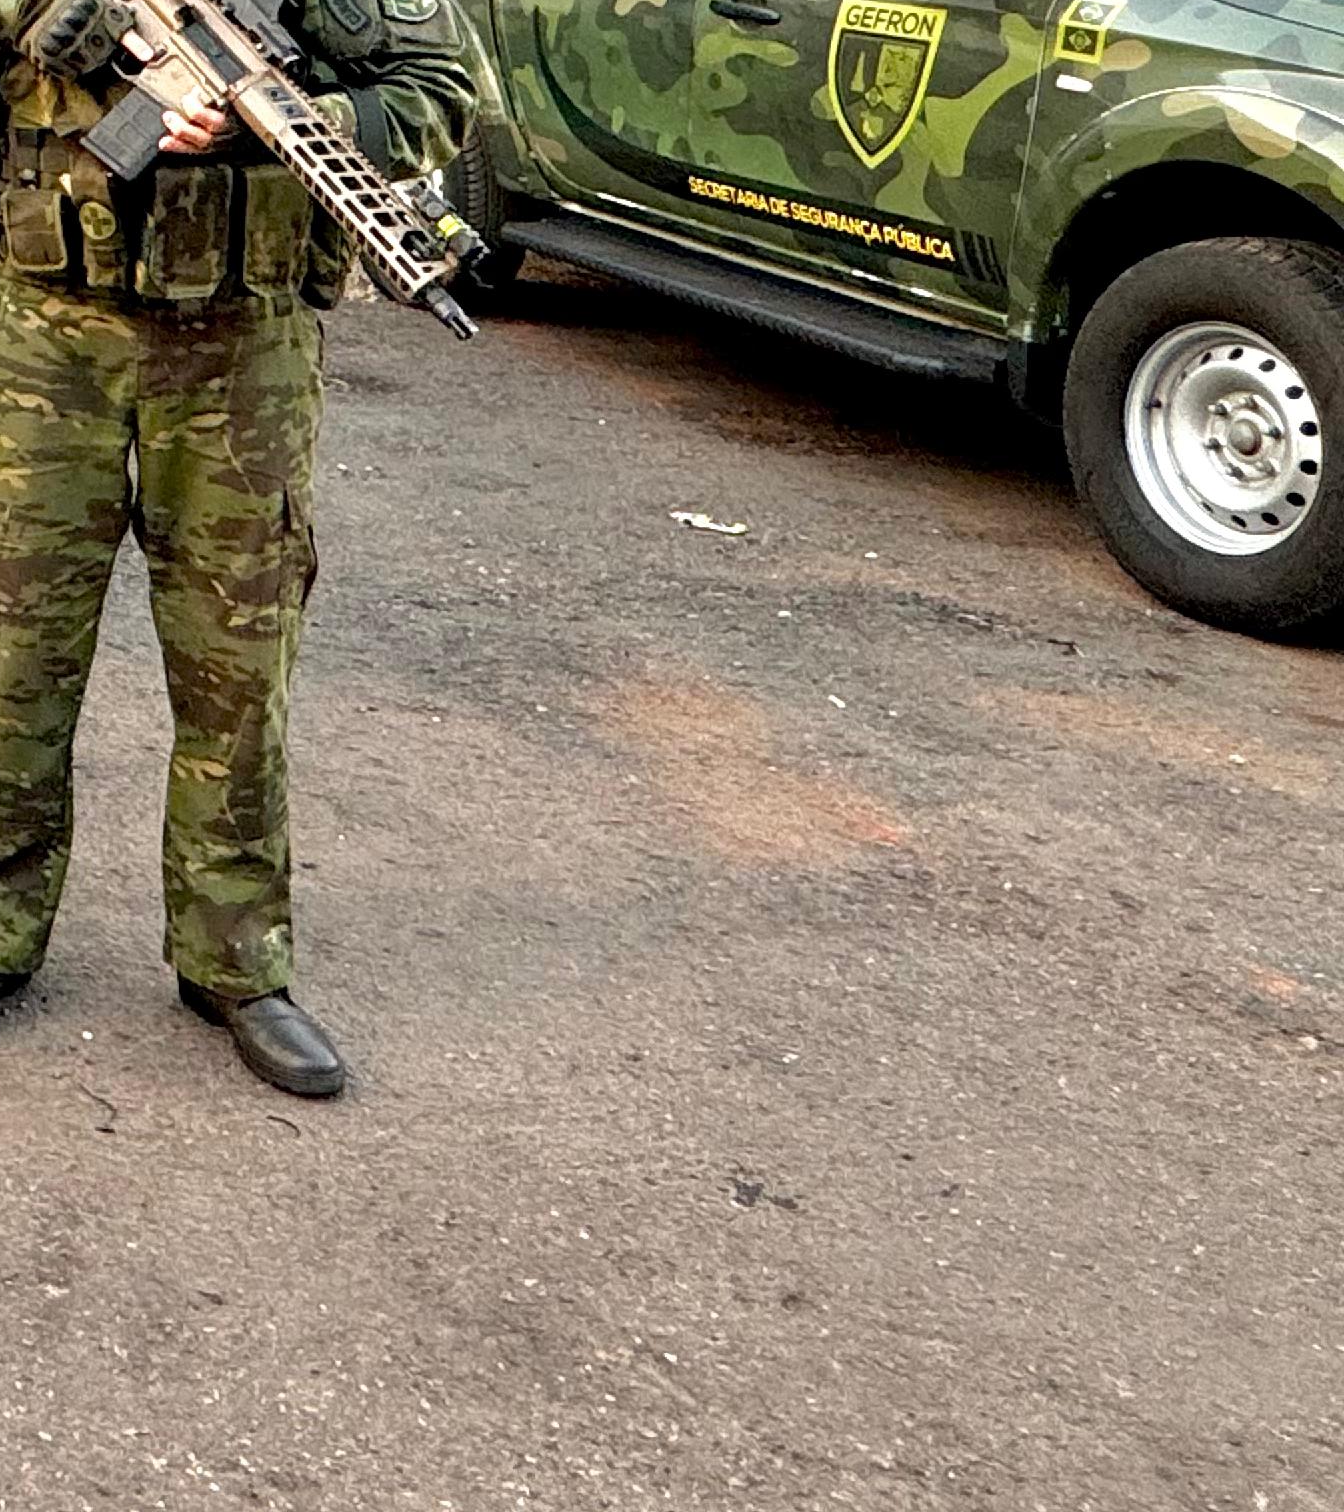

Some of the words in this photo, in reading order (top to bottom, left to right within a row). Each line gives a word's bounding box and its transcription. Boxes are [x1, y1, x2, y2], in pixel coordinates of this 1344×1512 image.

[846, 4, 938, 36] GEFRON
[688, 174, 770, 215] SECRETARIA
[770, 197, 791, 218] DE
[790, 201, 883, 246] SEGURANÇA
[884, 223, 956, 262] PÚBLICA
